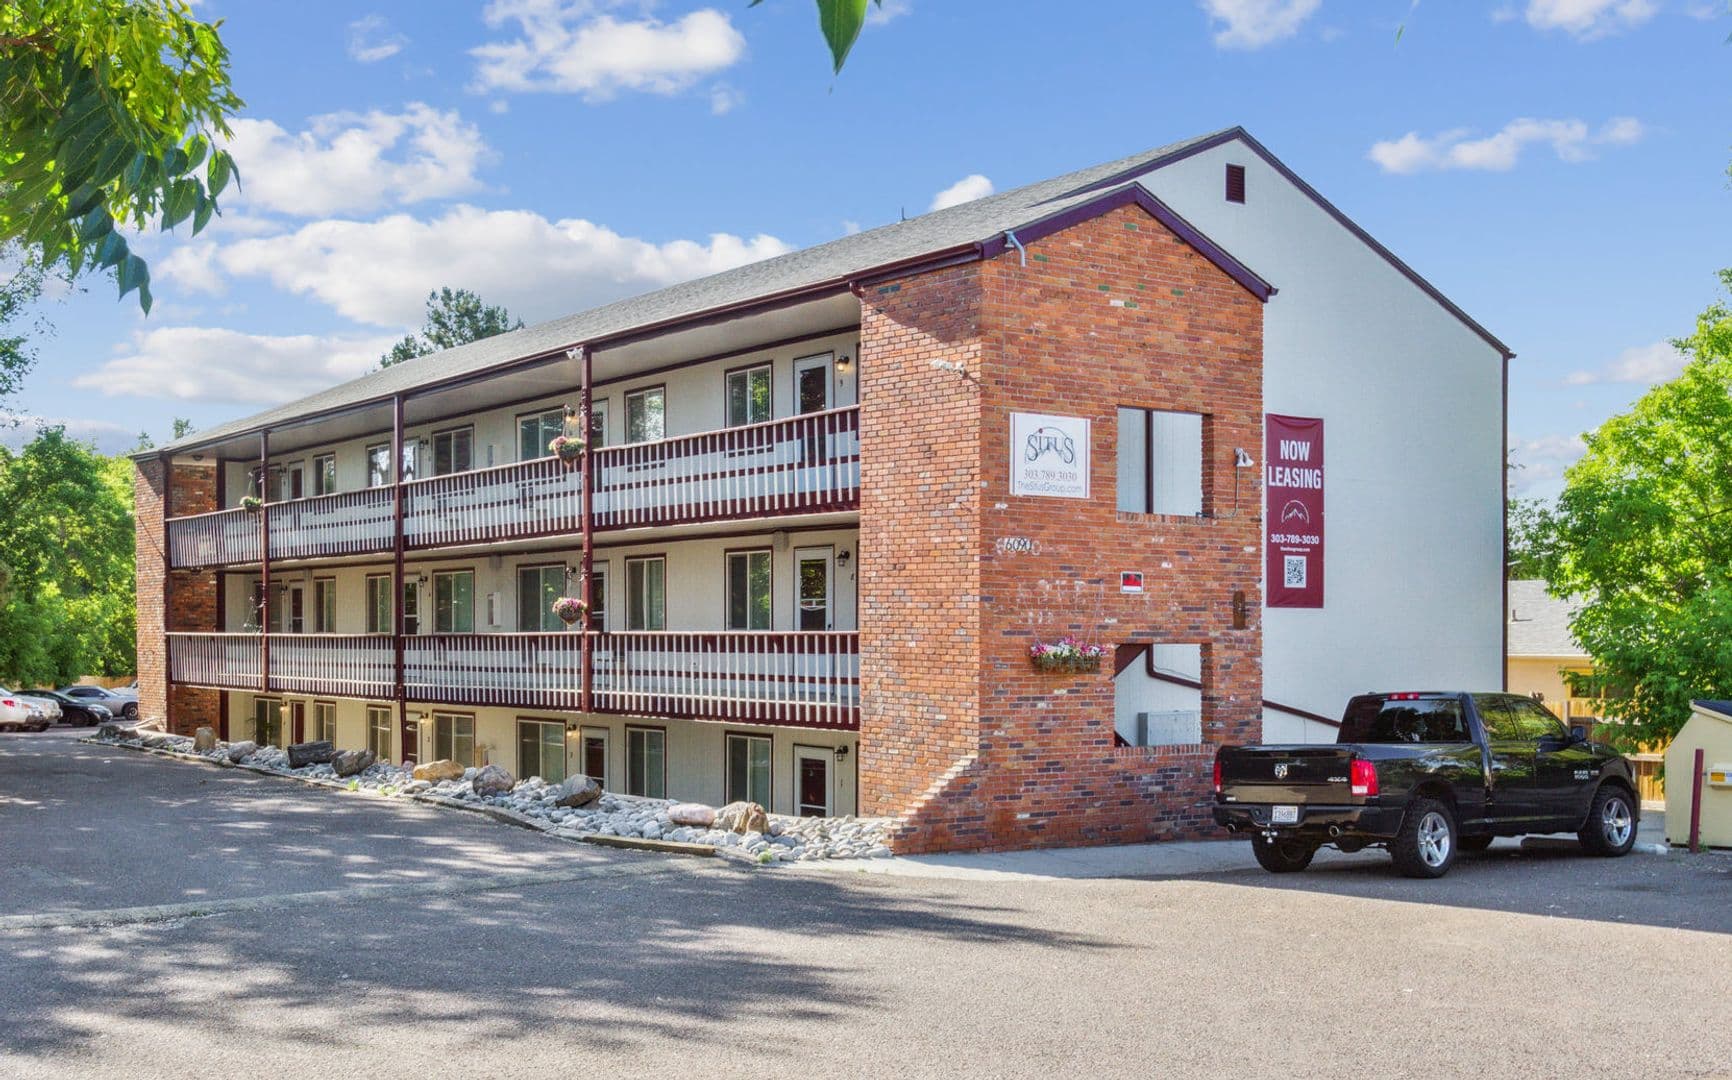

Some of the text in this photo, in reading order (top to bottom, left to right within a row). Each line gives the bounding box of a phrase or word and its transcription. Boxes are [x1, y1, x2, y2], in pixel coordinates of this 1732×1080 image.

[1280, 440, 1310, 461] NOW
[1268, 466, 1321, 489] LEASING
[1271, 533, 1319, 544] 303-789-3030
